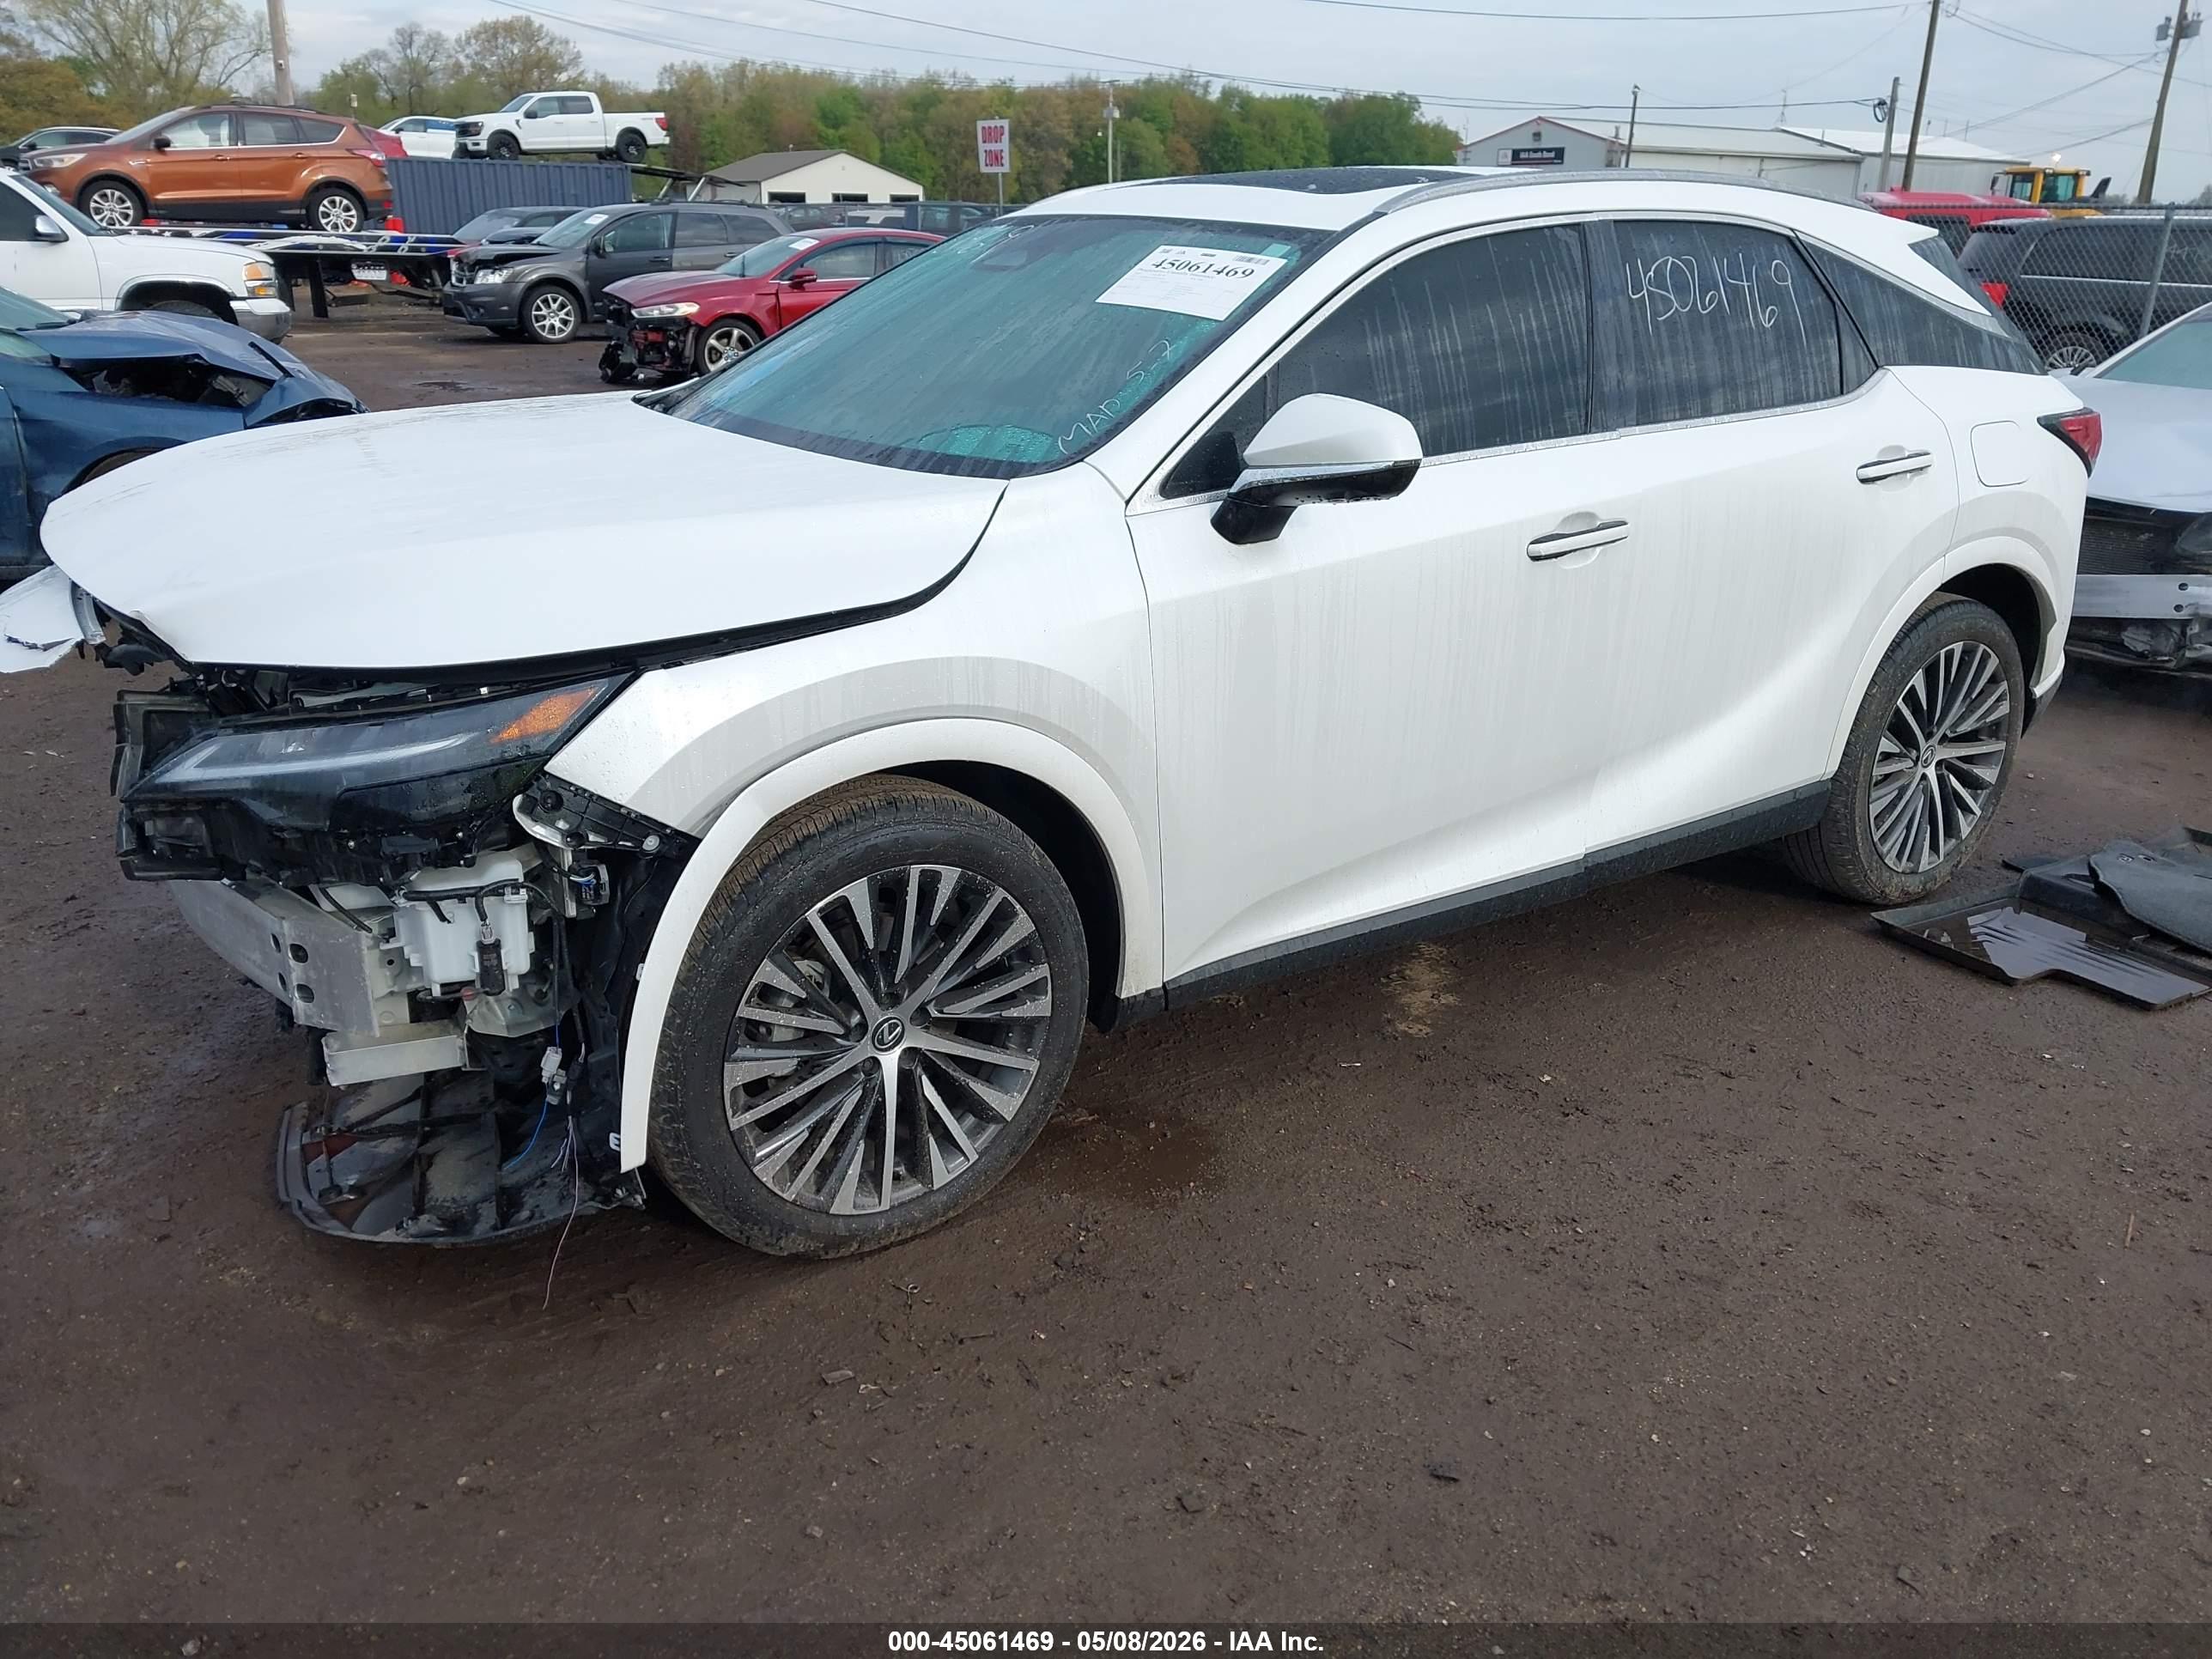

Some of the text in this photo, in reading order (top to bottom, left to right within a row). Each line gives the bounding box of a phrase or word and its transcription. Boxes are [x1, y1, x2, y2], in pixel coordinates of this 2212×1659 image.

[981, 125, 1004, 143] DROP
[984, 149, 1004, 167] ZONE
[1151, 258, 1255, 279] 45061469
[1626, 252, 1808, 346] 45061469
